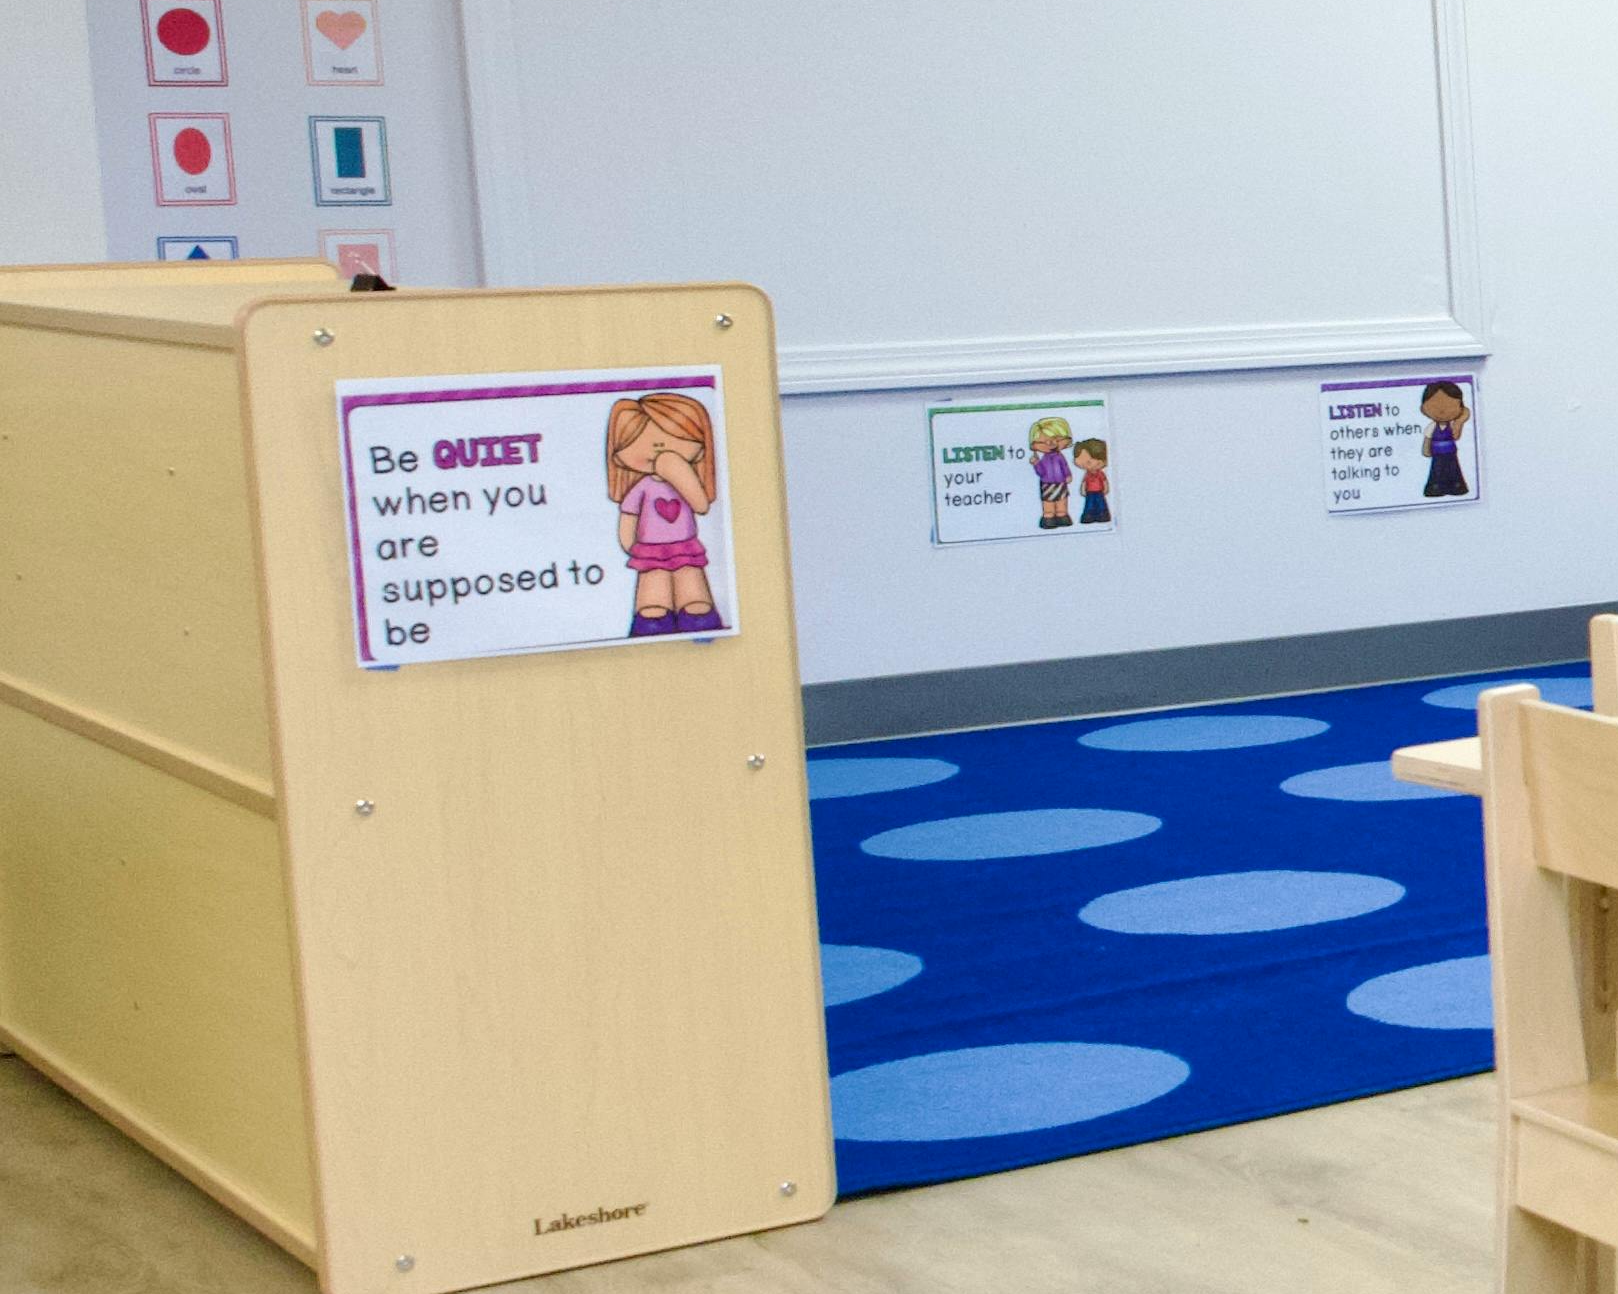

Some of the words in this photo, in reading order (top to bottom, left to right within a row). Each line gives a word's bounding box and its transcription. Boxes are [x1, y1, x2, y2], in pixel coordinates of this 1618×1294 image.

[1328, 402, 1383, 421] LISTEN
[1384, 403, 1401, 418] to
[1330, 425, 1380, 441] others
[1383, 422, 1422, 437] when
[369, 444, 419, 475] Be
[432, 433, 543, 471] QUIET
[943, 445, 1005, 464] LISTEN
[1007, 445, 1026, 460] to
[1331, 446, 1365, 463] they
[1368, 445, 1393, 458] are
[943, 471, 984, 489] your
[1331, 465, 1381, 482] talking
[1384, 463, 1401, 477] to
[372, 485, 472, 517] when
[482, 481, 548, 518] you
[944, 489, 1013, 507] teacher
[1333, 488, 1362, 505] you
[375, 533, 440, 561] are
[380, 562, 560, 607] supposed
[567, 558, 605, 588] to
[383, 617, 432, 646] be
[533, 1202, 648, 1237] Lakeshore
